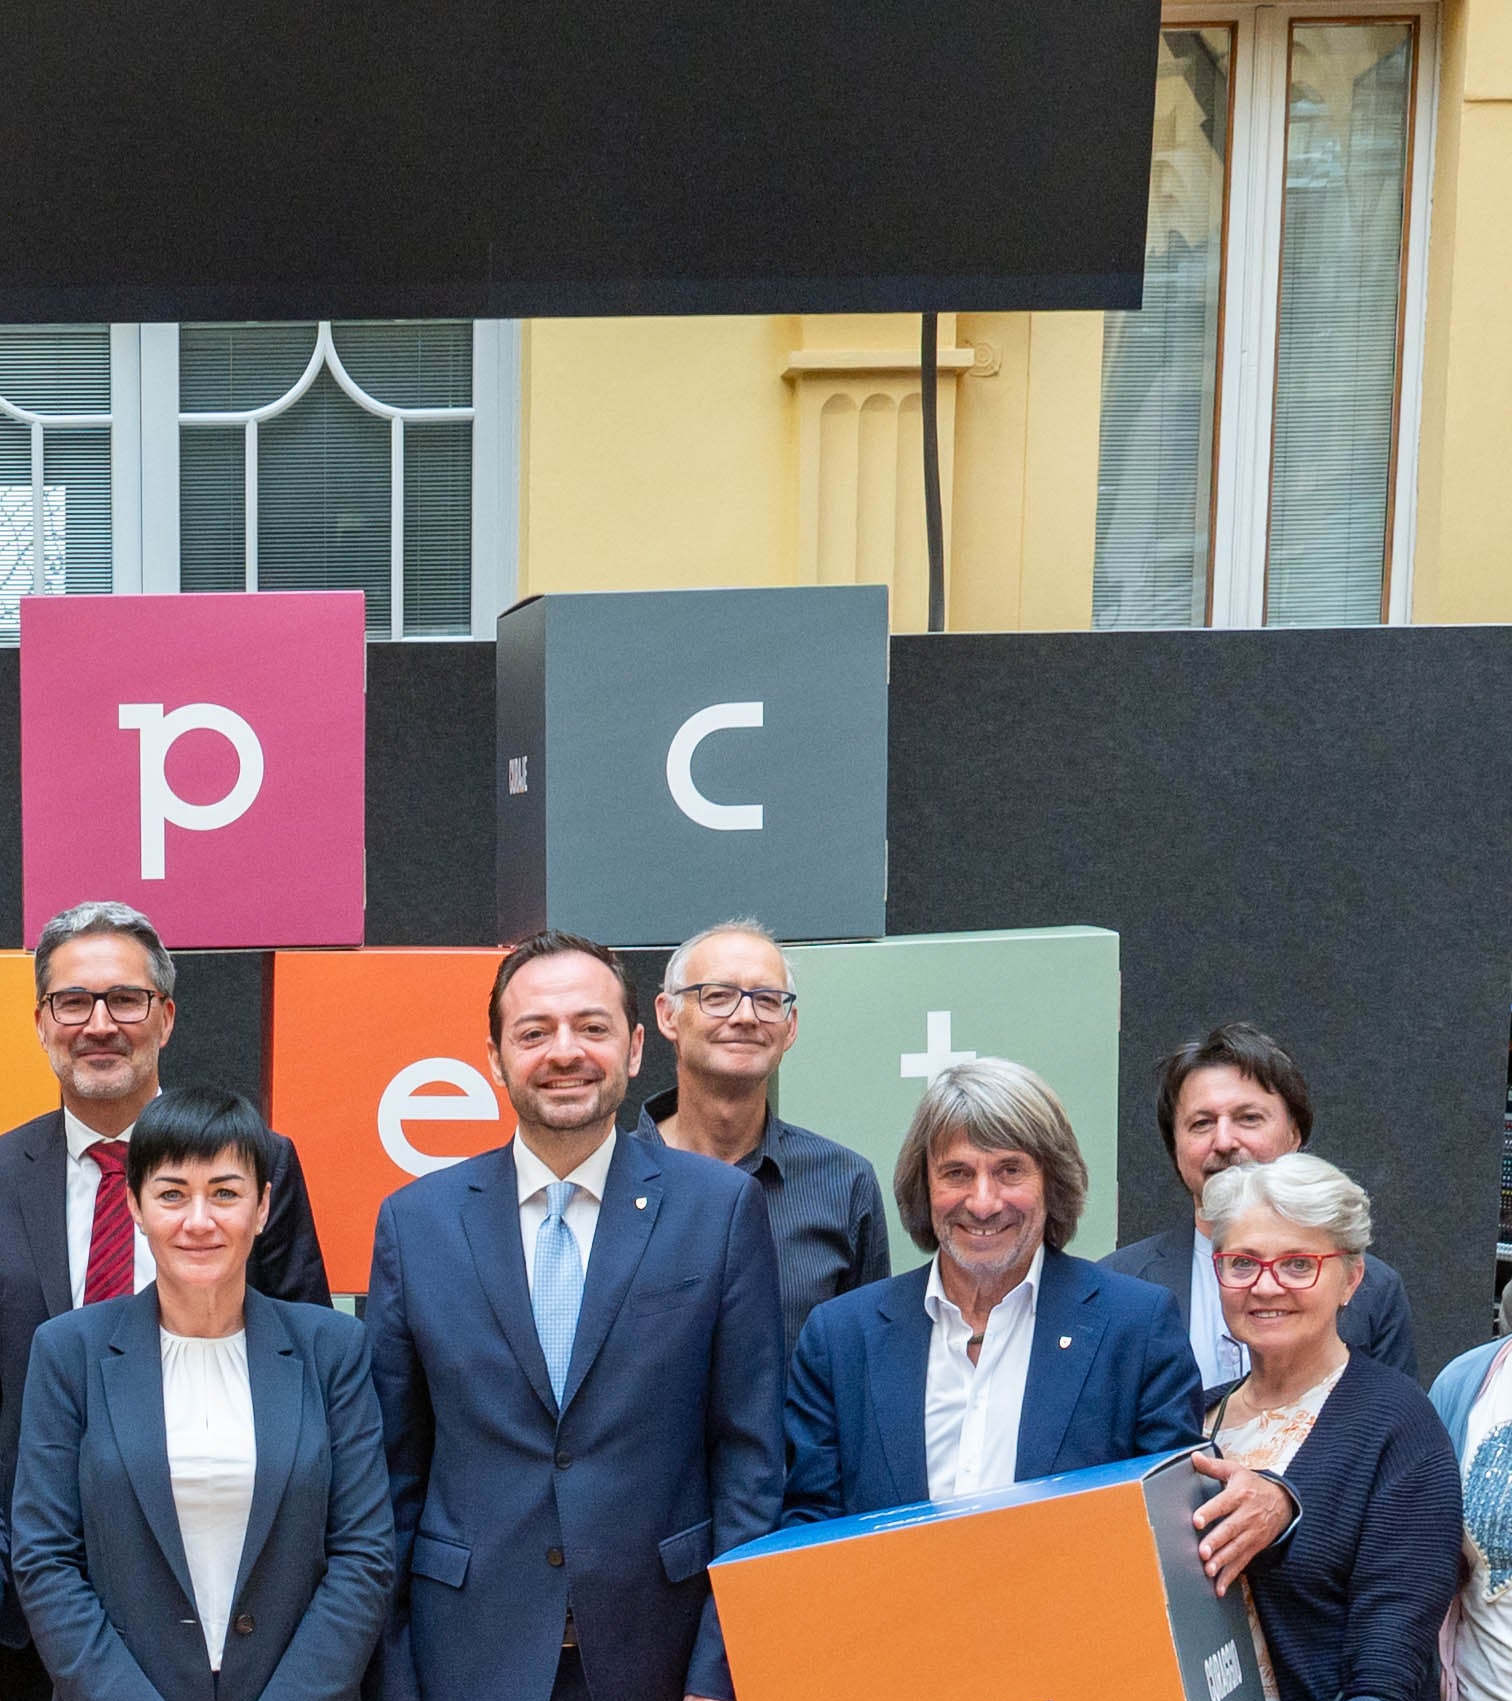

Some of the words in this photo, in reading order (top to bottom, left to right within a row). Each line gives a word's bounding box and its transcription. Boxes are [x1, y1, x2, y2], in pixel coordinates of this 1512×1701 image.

[118, 703, 264, 880] p
[666, 701, 764, 831] c
[377, 1056, 500, 1178] e
